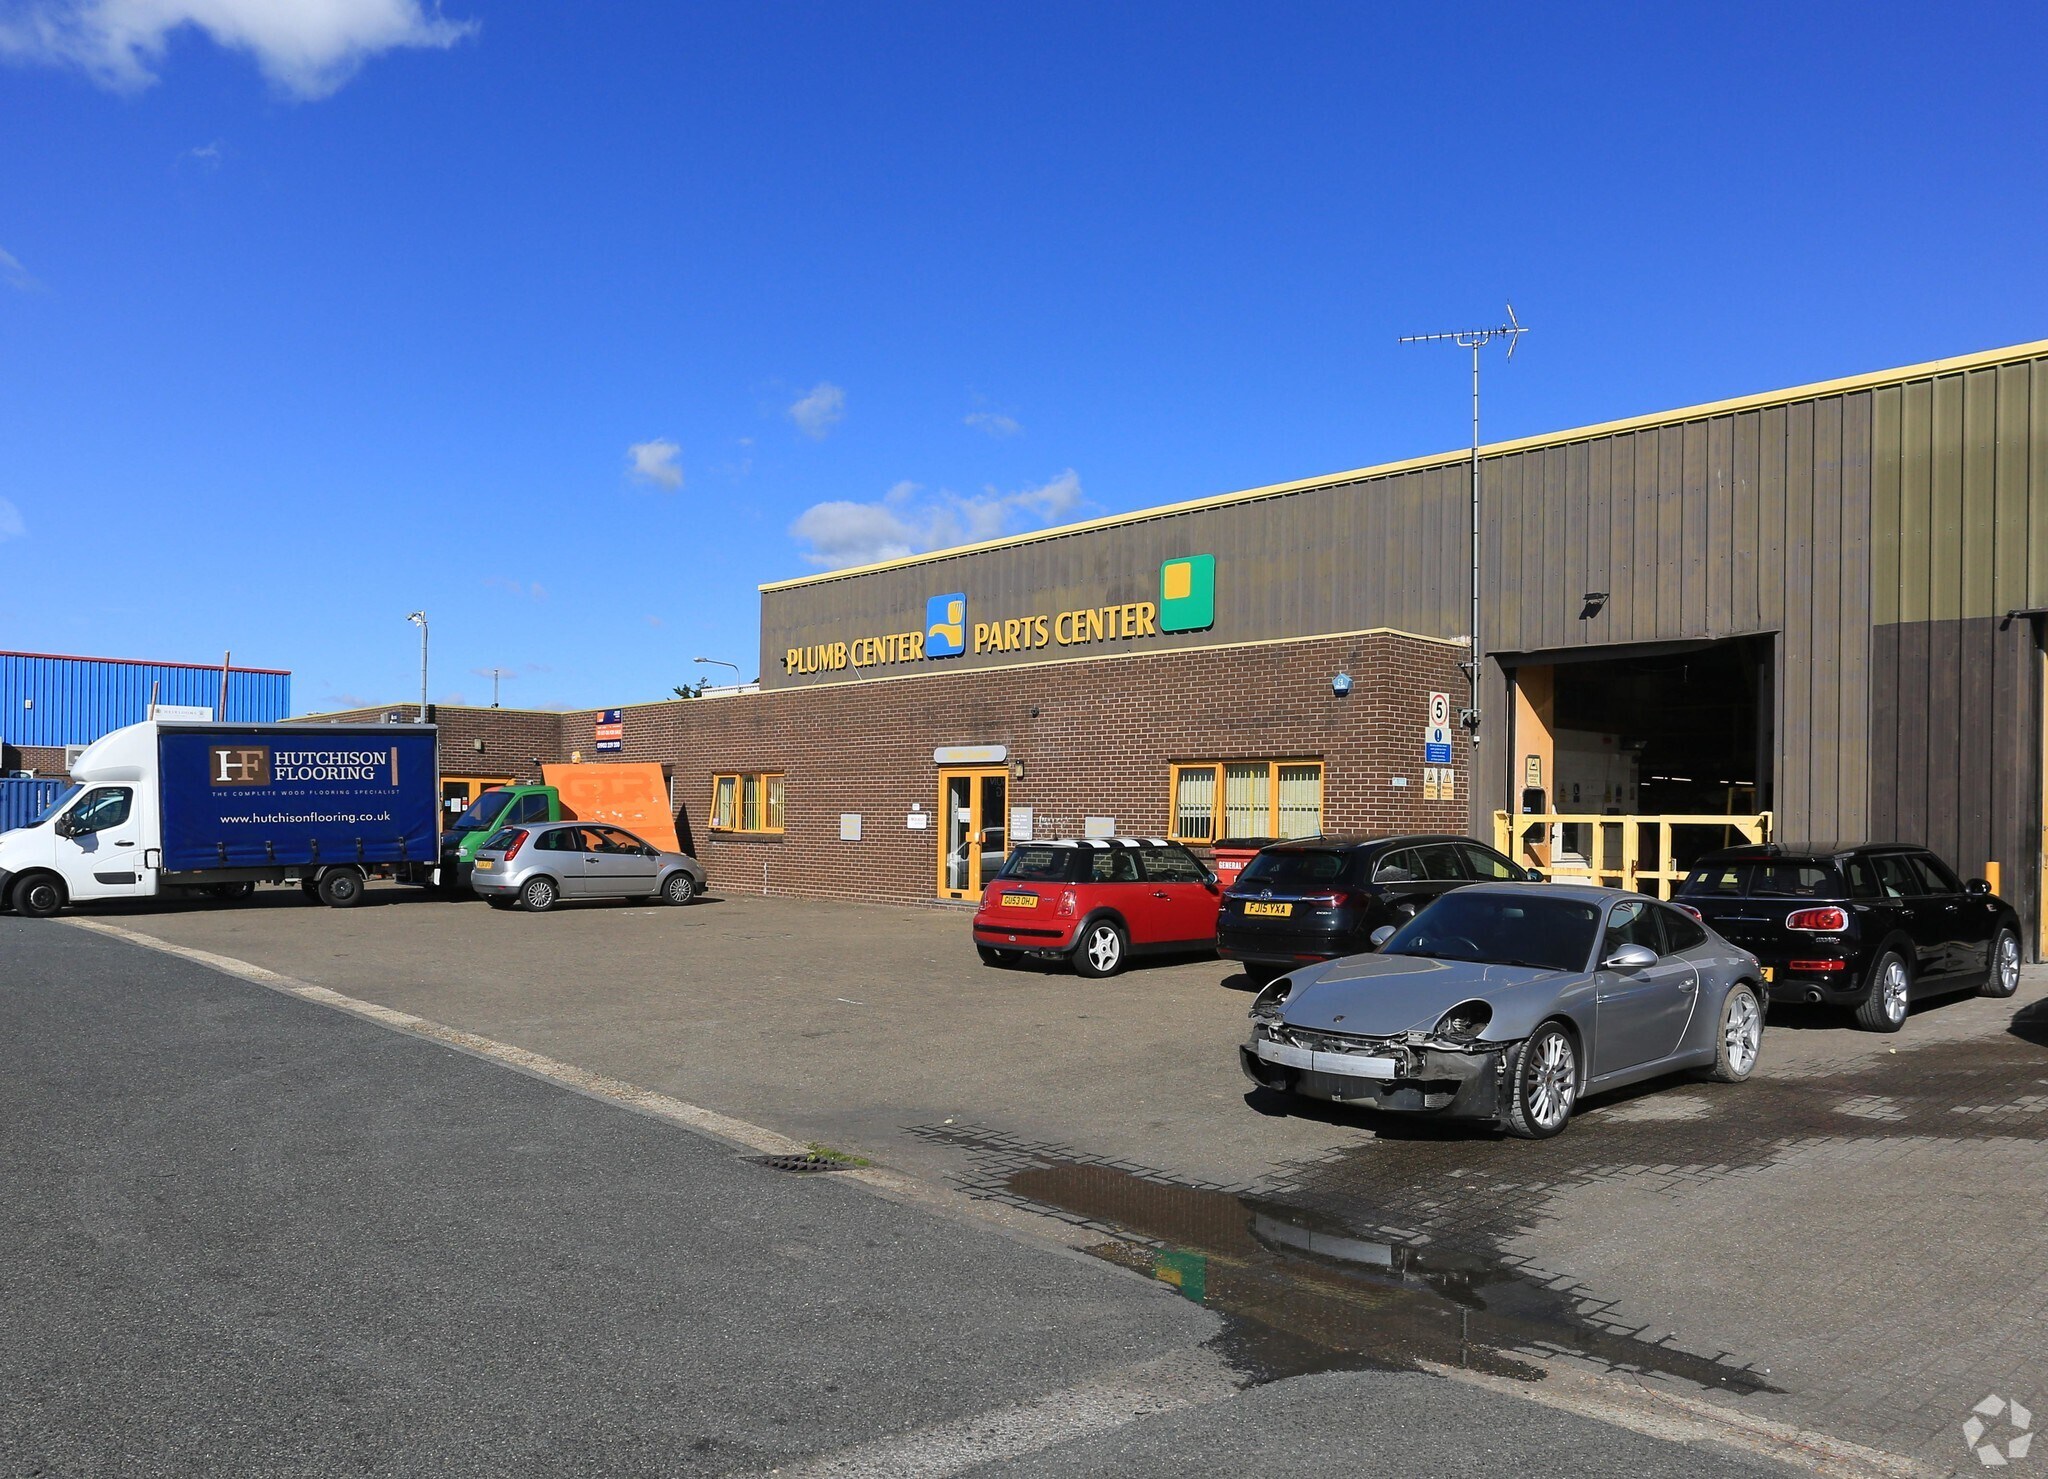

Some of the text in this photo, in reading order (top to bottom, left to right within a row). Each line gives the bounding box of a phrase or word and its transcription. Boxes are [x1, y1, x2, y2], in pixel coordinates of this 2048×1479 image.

[974, 601, 1157, 653] PARTS CENTER
[786, 631, 924, 675] PLUMB CENTER
[1435, 701, 1443, 719] 5
[274, 751, 387, 766] HUTCHISON
[275, 766, 375, 781] FLOORING
[220, 811, 391, 824] www.hutchisonflooring.co.uk
[1218, 861, 1242, 870] GENERAL
[1249, 903, 1286, 914] FJ15 YXA
